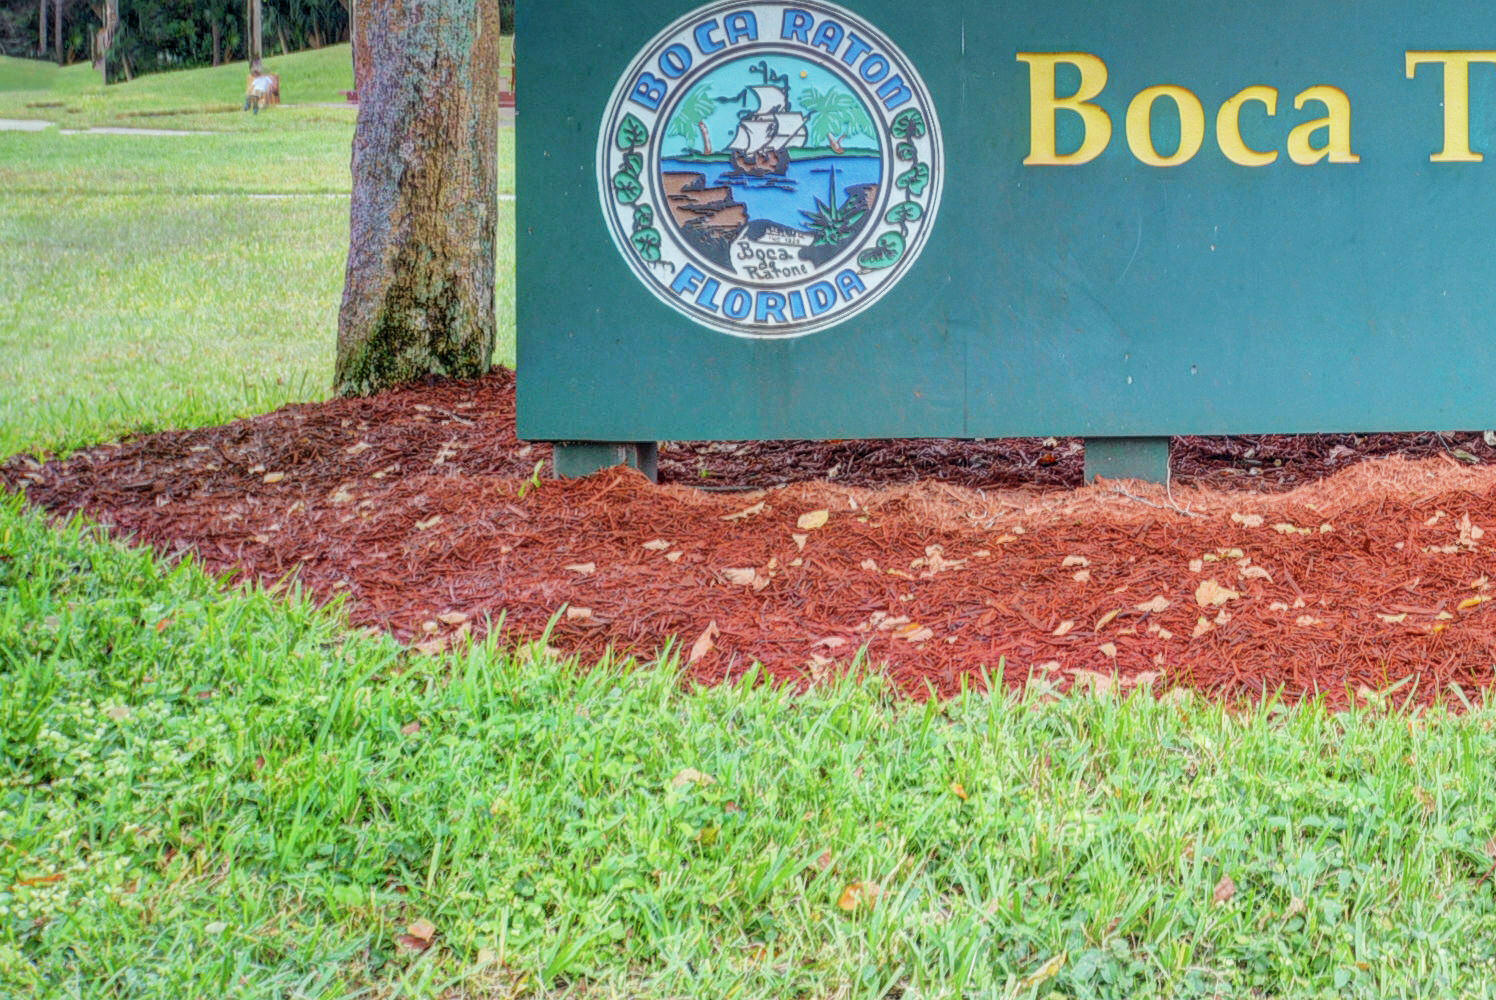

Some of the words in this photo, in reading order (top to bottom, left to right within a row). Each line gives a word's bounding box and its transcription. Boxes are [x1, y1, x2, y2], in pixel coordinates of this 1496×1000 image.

[629, 9, 758, 112] BOCA
[780, 8, 913, 111] RATON
[1015, 50, 1360, 167] Boca
[737, 241, 793, 261] Boca
[670, 263, 868, 323] FLORIDA
